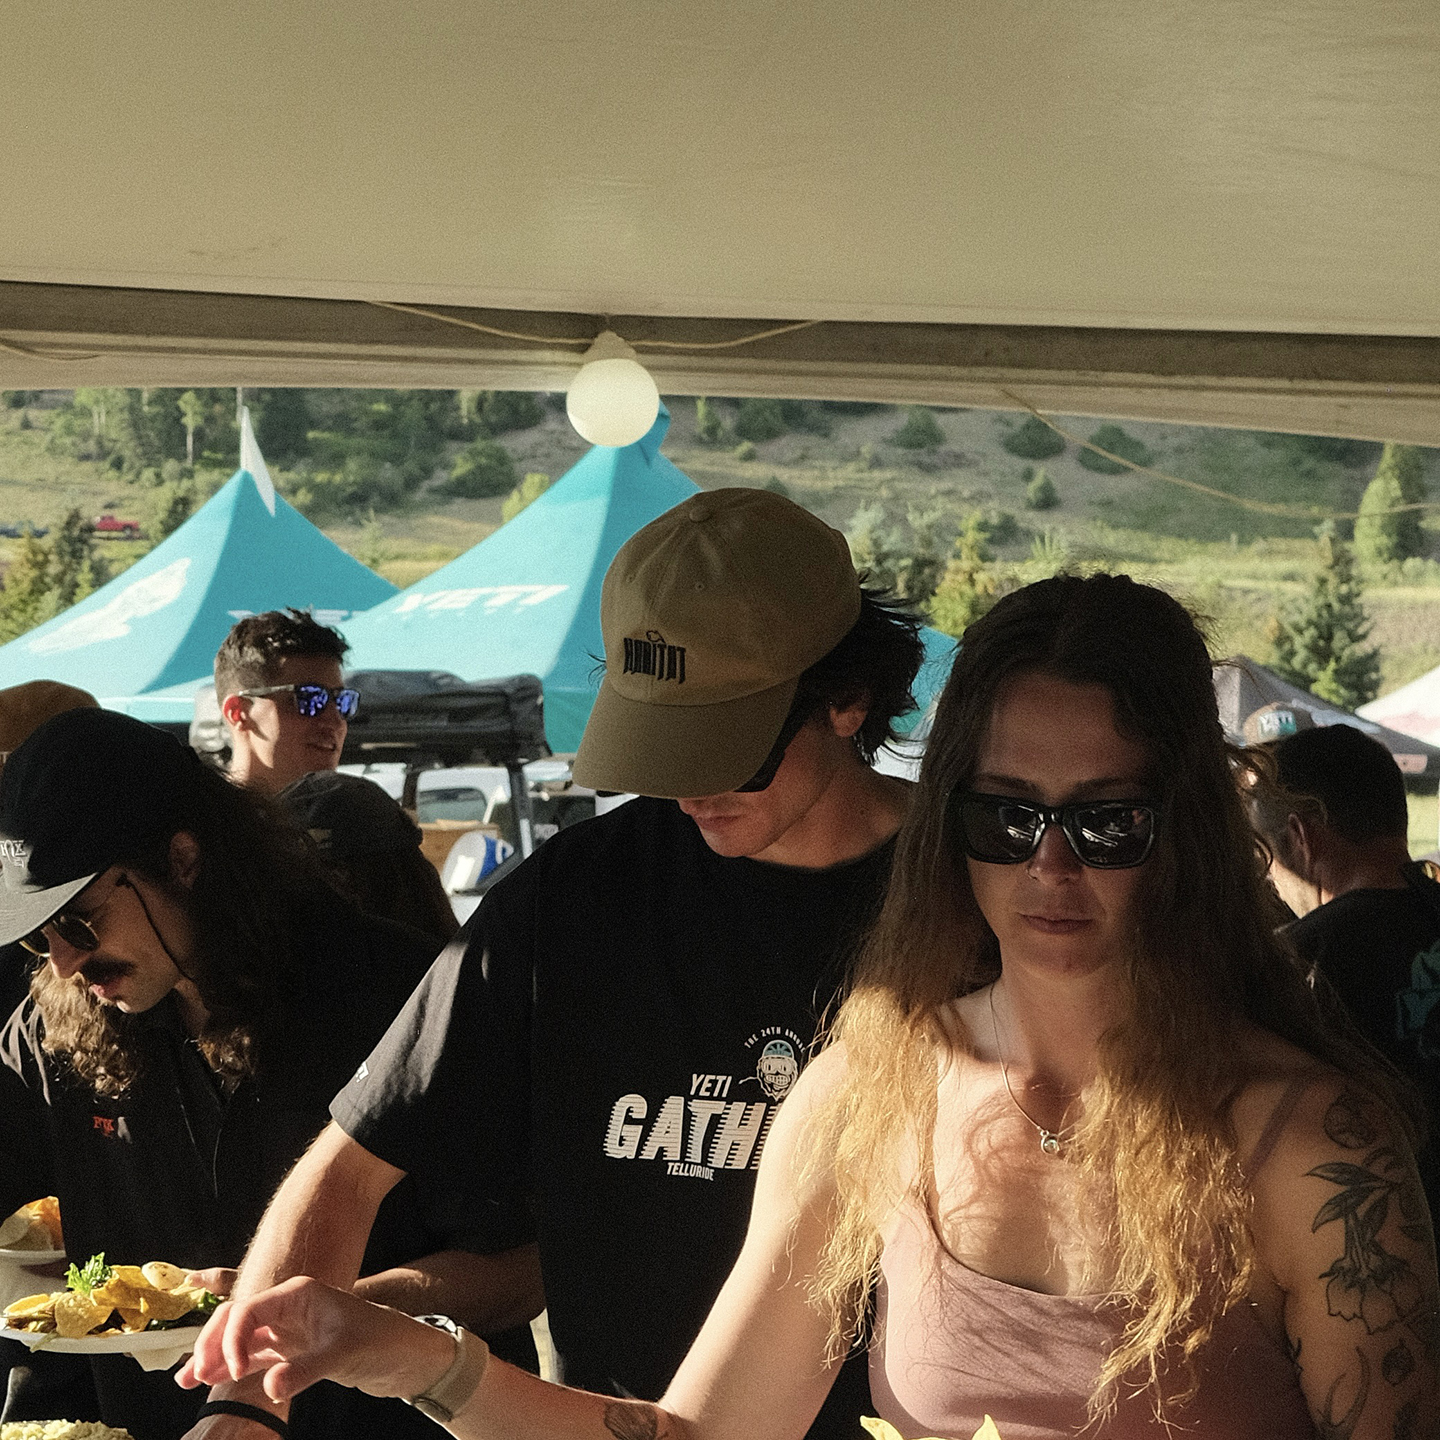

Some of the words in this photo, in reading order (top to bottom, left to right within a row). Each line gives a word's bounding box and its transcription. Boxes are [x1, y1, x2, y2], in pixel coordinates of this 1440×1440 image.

[744, 1033, 759, 1049] THE
[760, 1026, 781, 1037] 24TH
[689, 1073, 733, 1098] YETI
[666, 1162, 715, 1181] TELLURIDE
